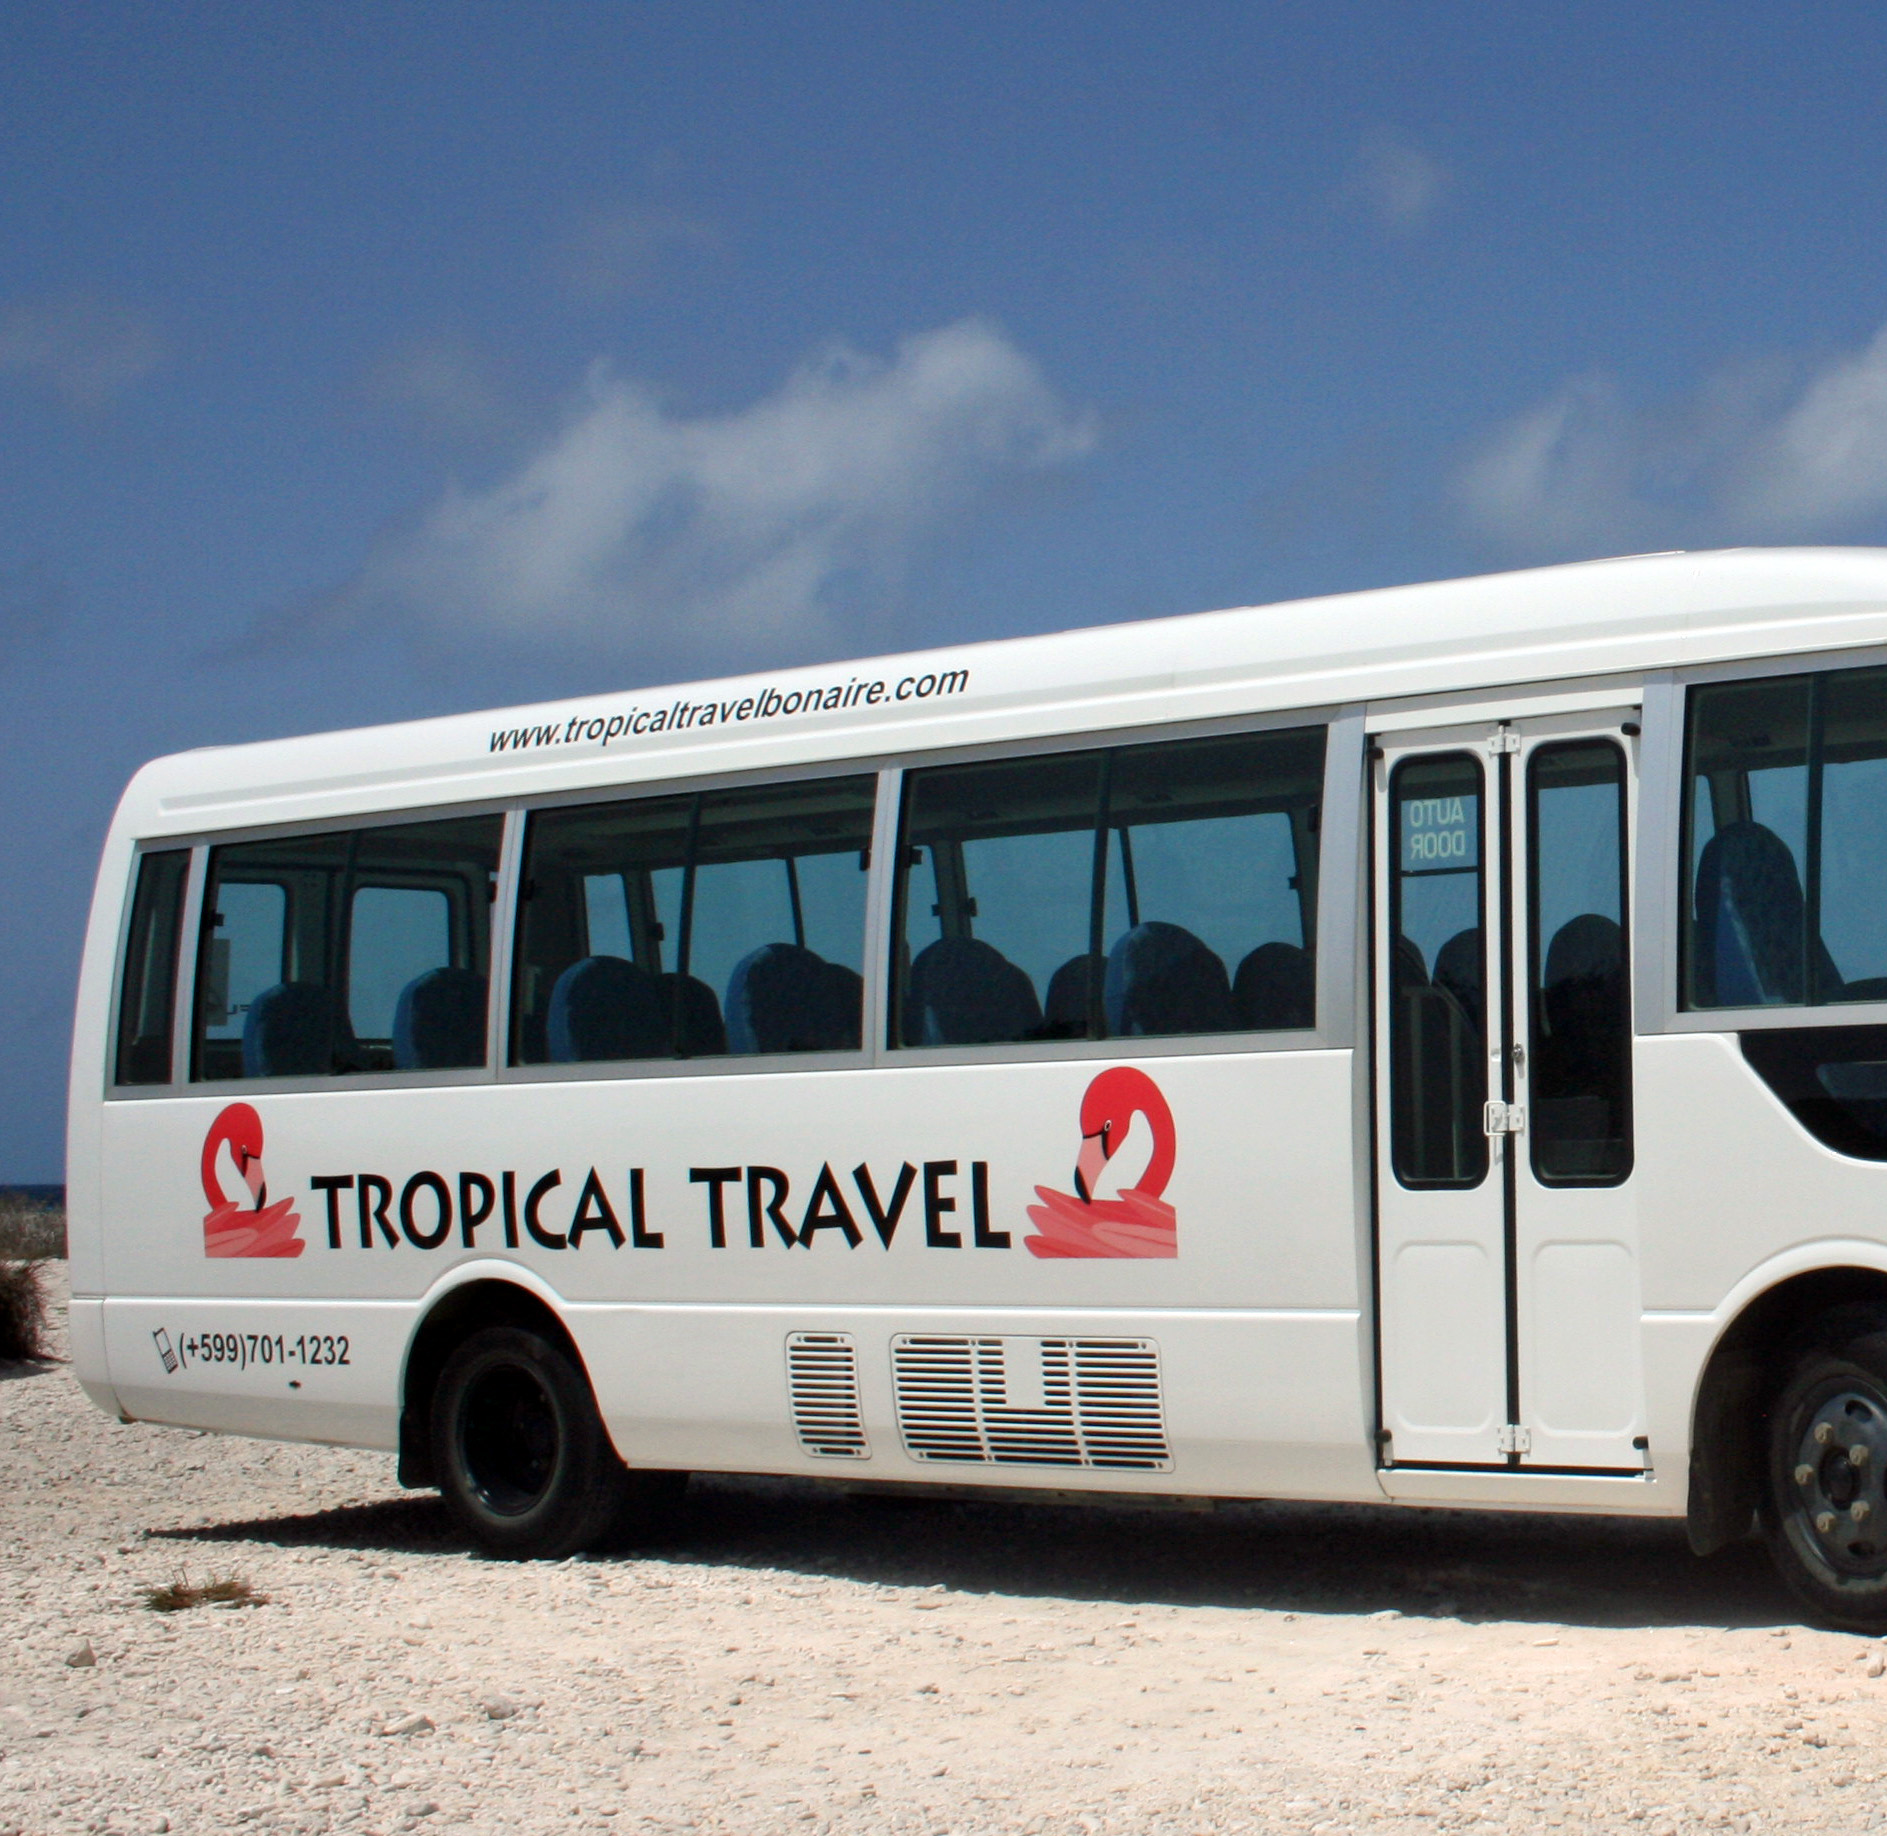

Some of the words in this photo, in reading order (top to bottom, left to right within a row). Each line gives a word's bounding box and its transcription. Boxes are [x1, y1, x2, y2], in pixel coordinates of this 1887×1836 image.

[488, 668, 970, 753] www.tropicaltravelbonaire.com
[310, 1166, 664, 1251] TROPICAL
[688, 1159, 1012, 1252] TRAVEL
[179, 1332, 351, 1371] (+599)701-1232
